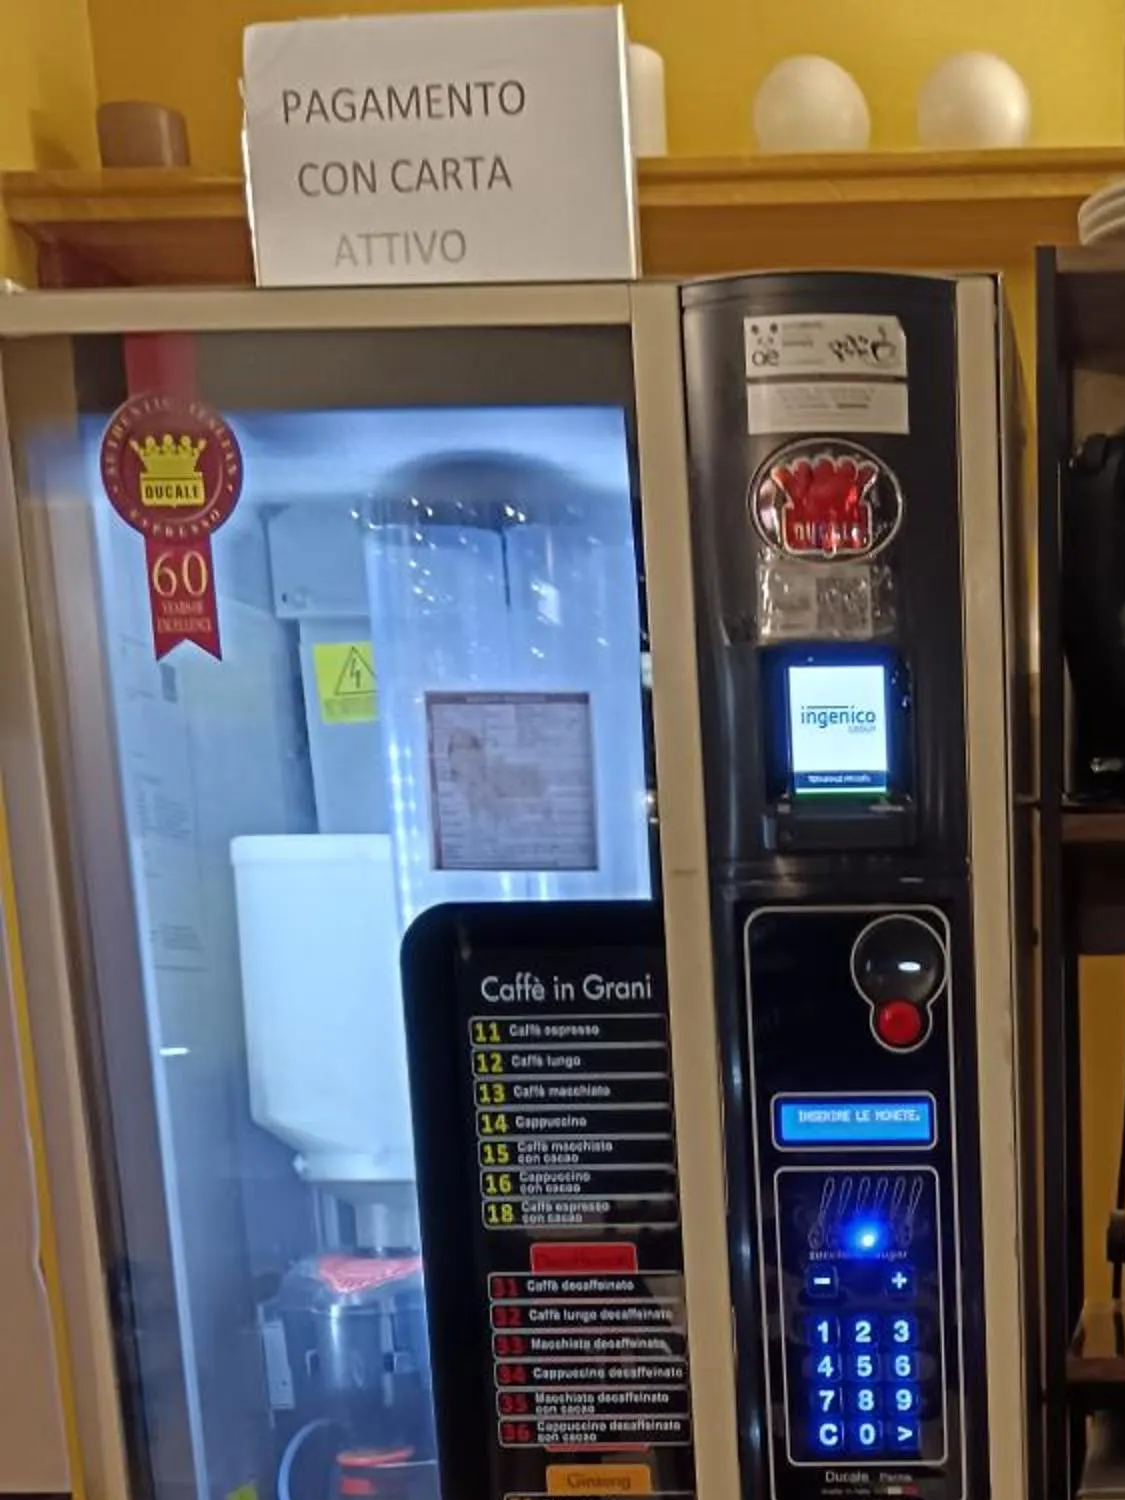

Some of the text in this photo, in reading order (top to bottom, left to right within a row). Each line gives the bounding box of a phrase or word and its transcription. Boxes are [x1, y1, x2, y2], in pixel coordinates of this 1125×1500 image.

[281, 80, 527, 125] PAGAMENTO
[298, 154, 513, 198] CON CARTA
[333, 229, 468, 268] ATTIVO
[144, 484, 200, 500] DUCALE
[152, 551, 209, 597] 60
[800, 705, 877, 729] ingenico
[480, 971, 653, 1003] Caffè in Grani
[474, 1022, 501, 1042] 11
[476, 1052, 504, 1073] 12
[478, 1083, 506, 1103] 13
[480, 1113, 509, 1134] 14
[483, 1144, 510, 1164] 15
[485, 1174, 513, 1194] 16
[487, 1204, 515, 1224] 18
[817, 1320, 911, 1343] 1 2 3
[817, 1355, 912, 1378] 4 5 6
[818, 1389, 913, 1412] 7 8 9
[818, 1423, 876, 1446] C 0
